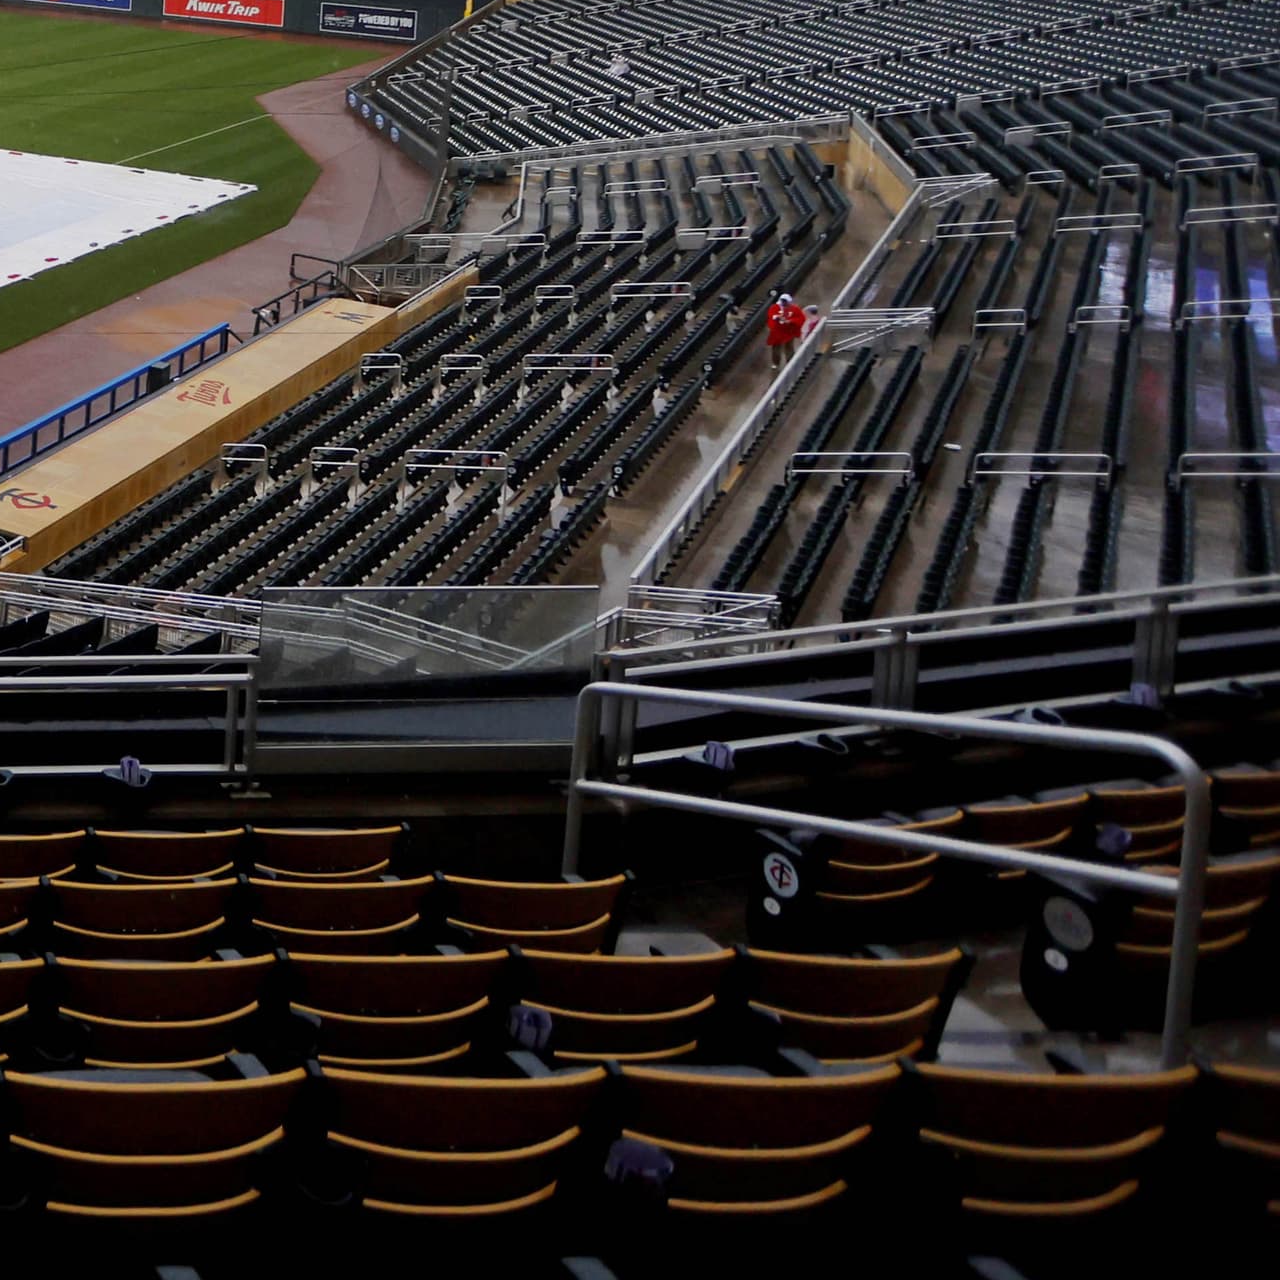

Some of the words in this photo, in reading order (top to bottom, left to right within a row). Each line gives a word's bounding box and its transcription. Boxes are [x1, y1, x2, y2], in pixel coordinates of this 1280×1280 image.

[226, 0, 260, 18] TRIP
[358, 13, 390, 26] POWERED
[390, 16, 399, 27] BY
[400, 17, 413, 28] YOU
